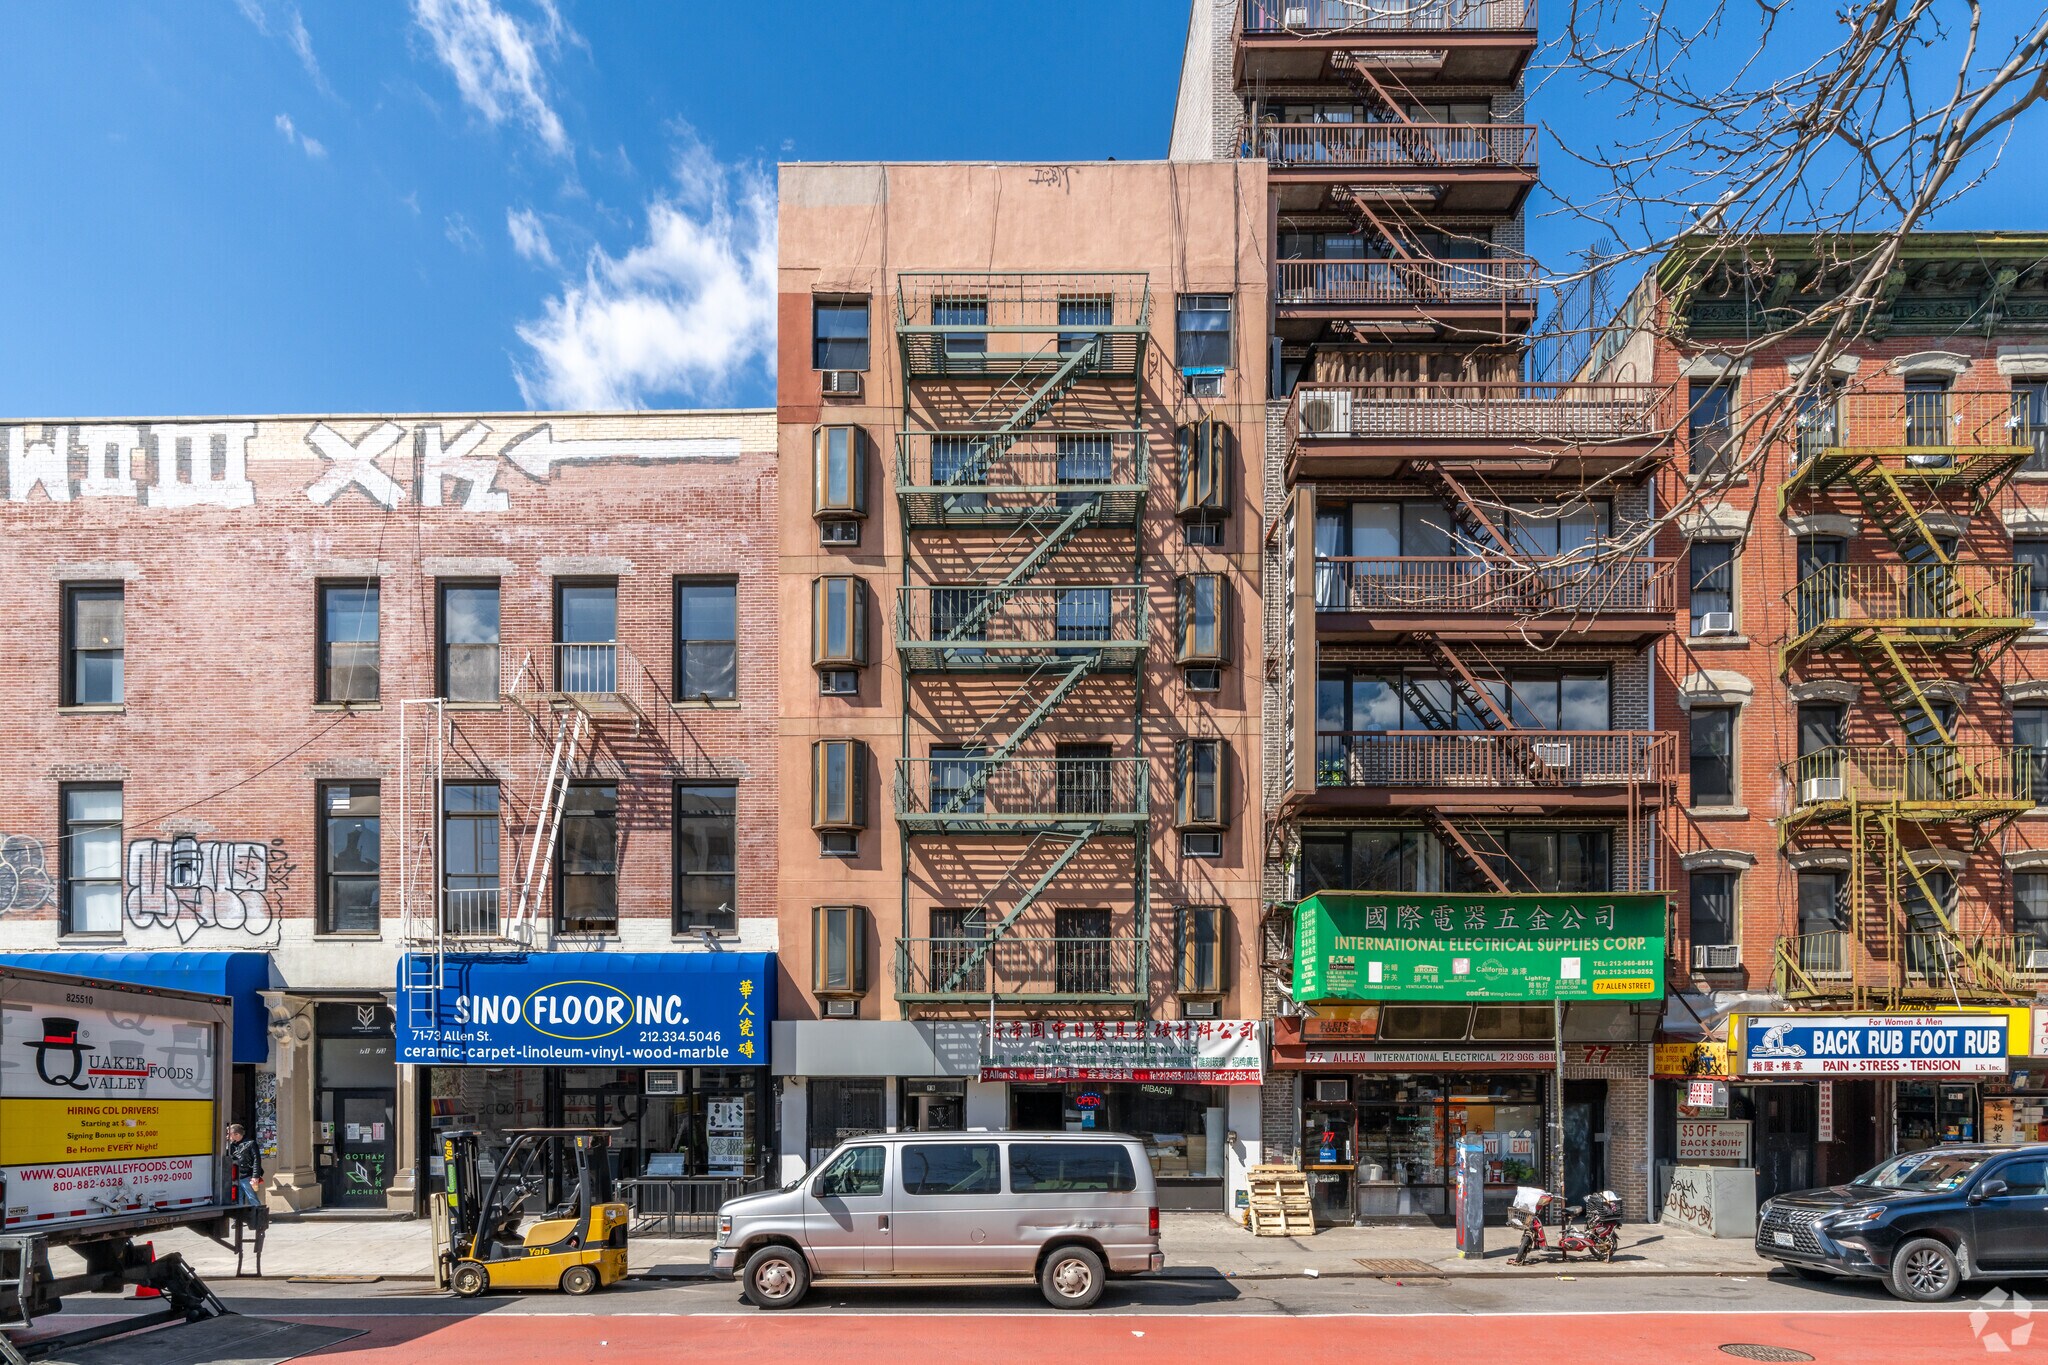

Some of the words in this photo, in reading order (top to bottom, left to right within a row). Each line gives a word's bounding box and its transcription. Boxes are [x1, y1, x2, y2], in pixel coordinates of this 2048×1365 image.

[1365, 903, 1615, 932] 國際電器五金公司
[1335, 935, 1445, 951] INTERNATIONAL
[1449, 937, 1533, 952] ELECTRICAL
[1537, 937, 1599, 951] SUPPLIES
[1603, 936, 1646, 951] CORP.
[66, 993, 93, 1005] 825510
[454, 995, 521, 1025] SINO
[534, 995, 625, 1025] FLOOR
[636, 994, 689, 1025] INC.
[1869, 1018, 1881, 1026] For
[1885, 1018, 1914, 1026] Women
[1916, 1018, 1922, 1026] &
[411, 1030, 442, 1041] 71-73
[444, 1030, 474, 1041] Allen
[476, 1030, 493, 1041] St.
[639, 1031, 721, 1042] 212.334.5046
[1813, 1030, 1861, 1055] BACK
[1868, 1030, 1903, 1055] RUB
[1910, 1030, 1959, 1055] FOOT
[1964, 1030, 2000, 1055] RUB
[1037, 1045, 1060, 1054] NEW
[1064, 1045, 1105, 1054] EMPIRE
[1108, 1045, 1156, 1054] TRADING
[1161, 1045, 1176, 1055] NY
[1179, 1046, 1201, 1055] INC.
[1582, 1045, 1612, 1064] 77
[1309, 1052, 1323, 1062] 77
[1333, 1052, 1366, 1062] ALLEN
[1374, 1053, 1439, 1062] INTERNATIONAL
[1443, 1052, 1496, 1062] ELECTRICAL
[1823, 1060, 1849, 1071] PAIN
[1860, 1060, 1900, 1071] STRESS
[1910, 1060, 1961, 1071] TENSION
[149, 1066, 193, 1079] FOODS
[989, 1069, 1009, 1079] Allen
[1009, 1069, 1019, 1079] St.
[89, 1076, 146, 1090] VALLEY
[1690, 1084, 1702, 1093] BACK
[1704, 1084, 1712, 1093] RUB
[1141, 1084, 1173, 1095] HIBACHI
[1076, 1095, 1100, 1106] OPEN
[1690, 1094, 1702, 1103] FOOT
[1704, 1094, 1712, 1104] RUB
[67, 1106, 101, 1115] HIRING
[102, 1106, 120, 1115] CDL
[121, 1106, 159, 1115] DRIVERS!
[81, 1119, 111, 1128] Starting
[112, 1119, 119, 1127] at
[67, 1132, 94, 1140] Signing
[95, 1131, 116, 1139] Bonus
[136, 1130, 158, 1138] $5,000!
[1322, 1131, 1335, 1142] 77
[1682, 1125, 1694, 1138] $5
[1697, 1125, 1717, 1137] OFF
[66, 1146, 77, 1154] Be
[80, 1145, 105, 1153] Home
[107, 1143, 134, 1152] EVERY
[136, 1142, 158, 1151] Night!
[1512, 1140, 1530, 1153] EXIT
[1680, 1139, 1708, 1147] BACK
[1711, 1139, 1742, 1147] $40/Hr
[445, 1140, 454, 1161] Yale
[1710, 1149, 1741, 1157] $30/Hr
[20, 1159, 193, 1181] WWW.QUAKERVALLEYFOODS.COM
[53, 1177, 123, 1192] 800-882-6328
[133, 1171, 192, 1185] 215-992-0900
[529, 1247, 550, 1256] Yale
